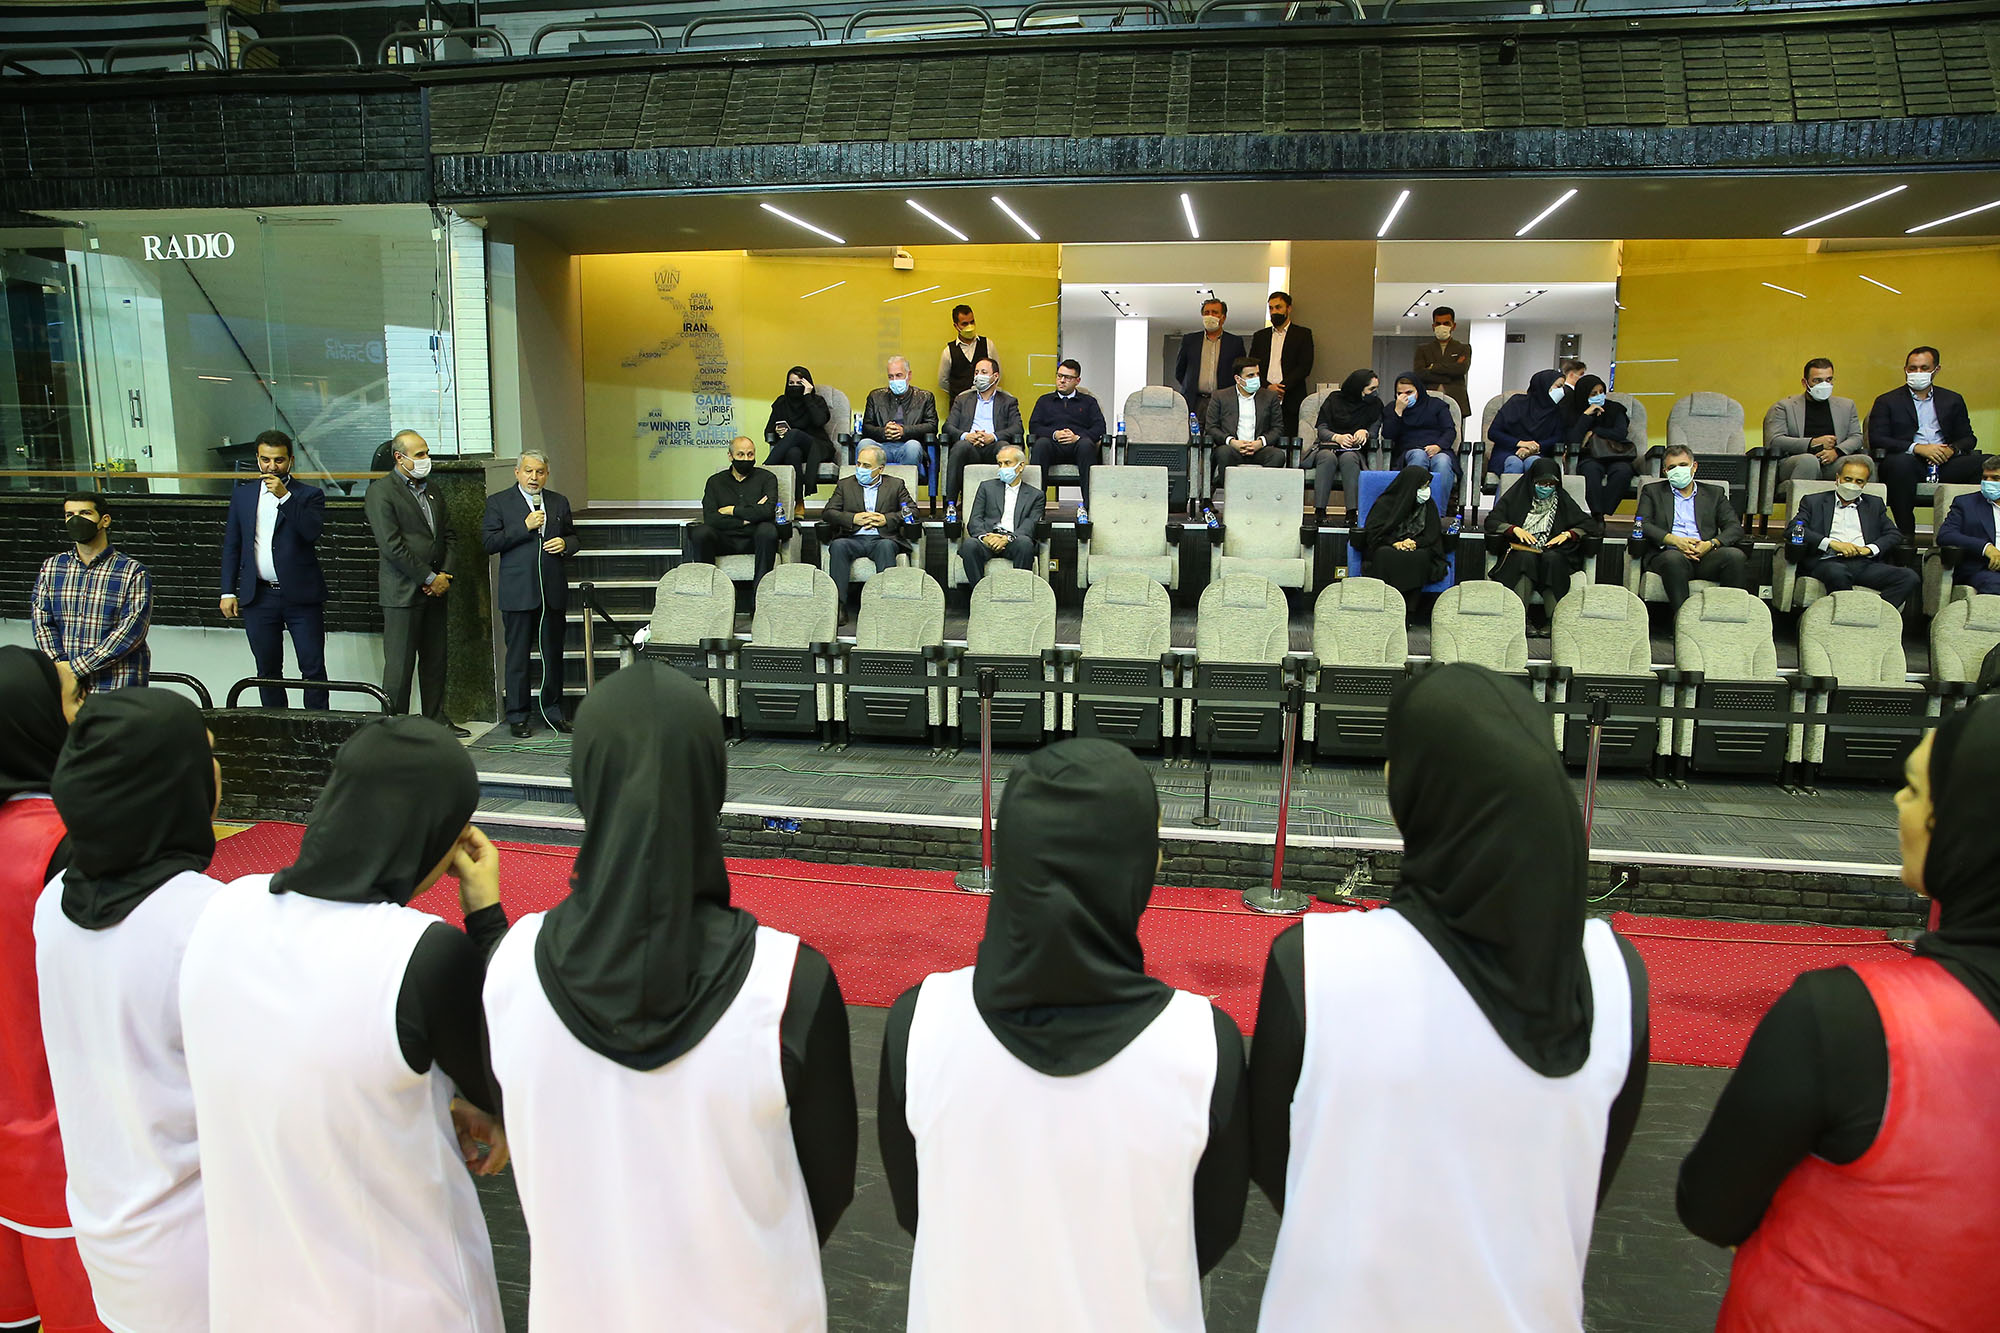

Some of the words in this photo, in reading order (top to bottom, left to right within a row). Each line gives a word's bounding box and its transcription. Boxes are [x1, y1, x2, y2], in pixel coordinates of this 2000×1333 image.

[141, 232, 235, 261] RADIO
[654, 271, 680, 284] WIN
[683, 323, 708, 332] IRAN
[695, 394, 732, 406] GAME
[650, 422, 691, 431] WINNER
[666, 431, 692, 440] HOPE
